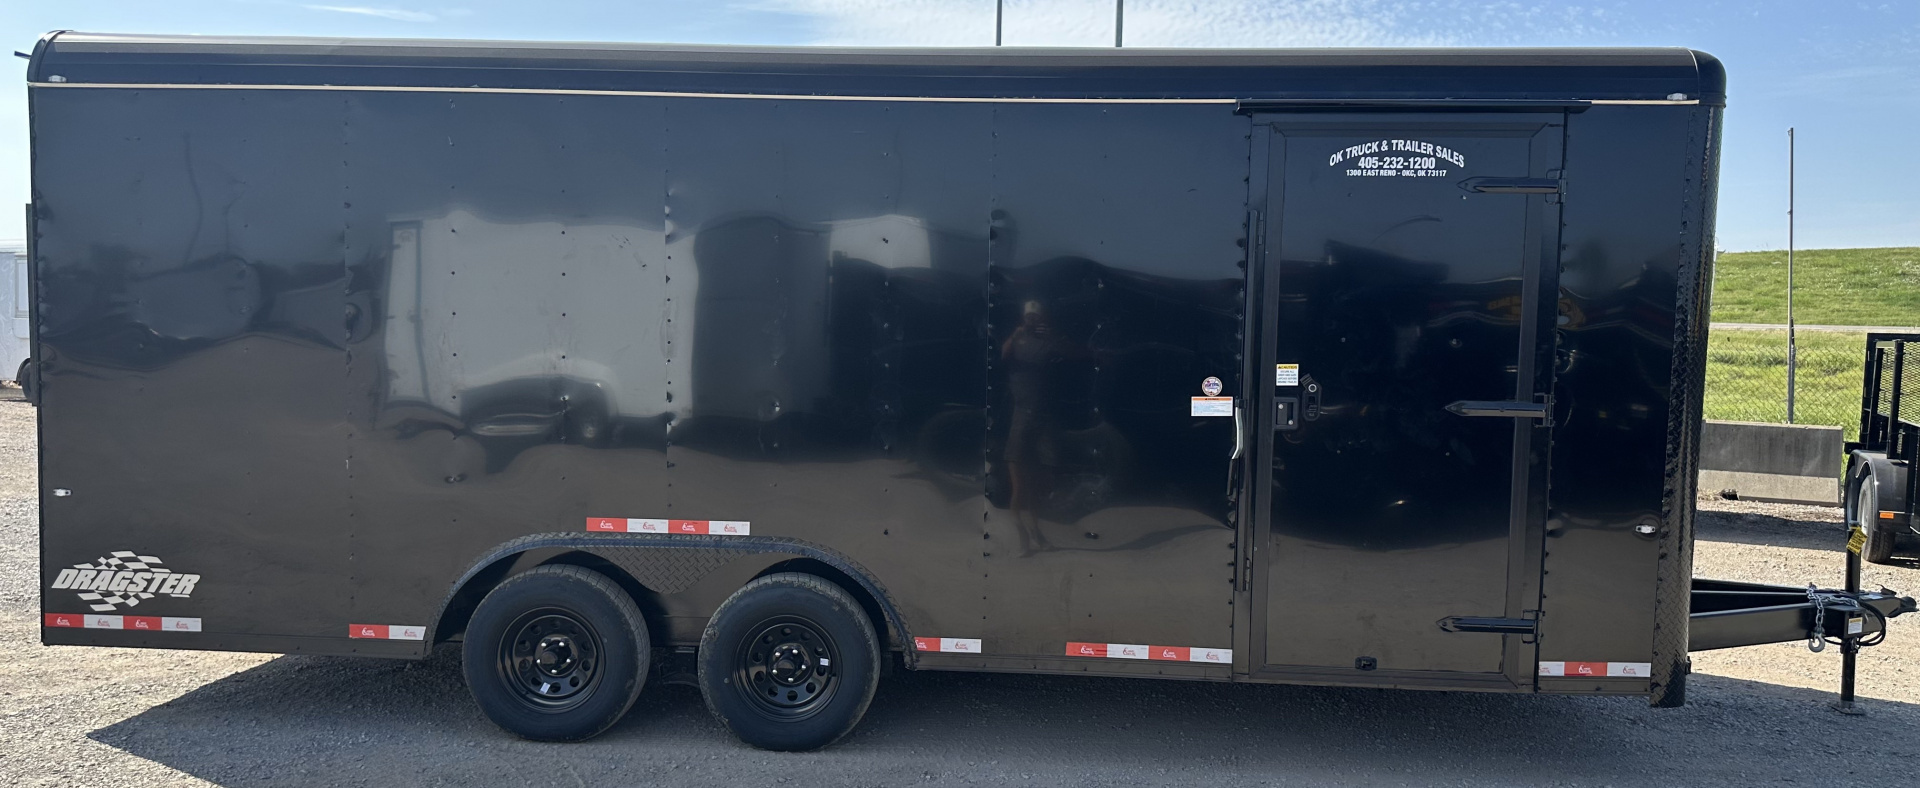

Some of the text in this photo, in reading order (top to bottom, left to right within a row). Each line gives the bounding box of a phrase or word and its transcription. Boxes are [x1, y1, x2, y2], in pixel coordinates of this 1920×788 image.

[1329, 139, 1465, 168] OK TRUCK & TRAILER SALES
[1357, 156, 1436, 169] 405-232-1200
[1346, 169, 1361, 177] 1300
[1362, 169, 1379, 177] EAST
[1379, 169, 1397, 177] RENO
[1401, 169, 1417, 178] OKC,
[1417, 169, 1427, 177] OK
[1427, 169, 1447, 177] 73117
[51, 568, 201, 596] DRAGSTER
